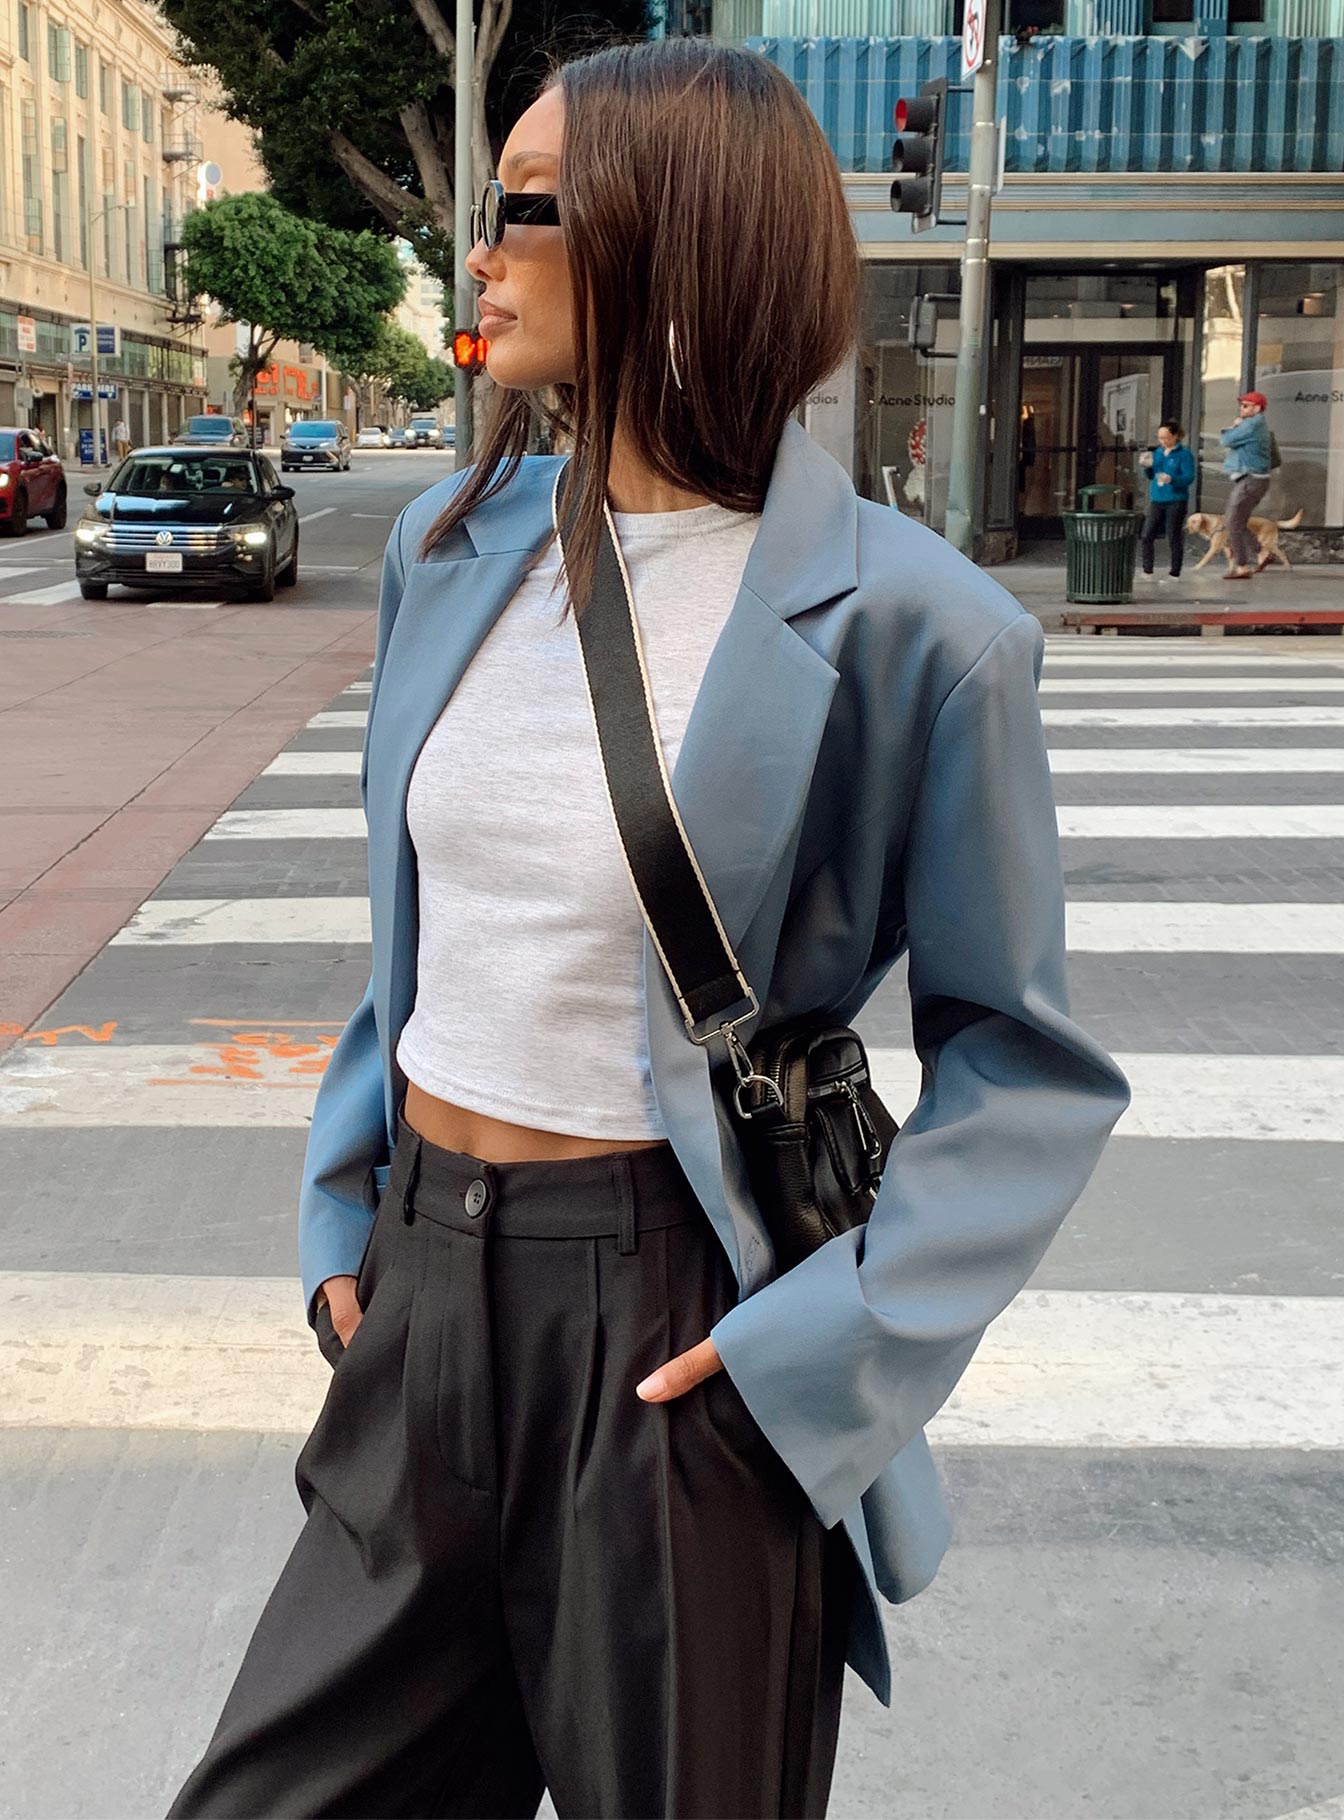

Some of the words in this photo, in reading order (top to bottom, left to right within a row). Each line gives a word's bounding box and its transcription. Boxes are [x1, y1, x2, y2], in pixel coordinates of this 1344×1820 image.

[72, 383, 93, 391] PARK
[879, 395, 912, 406] Acne
[914, 394, 956, 406] Studio
[1295, 390, 1329, 402] Acne
